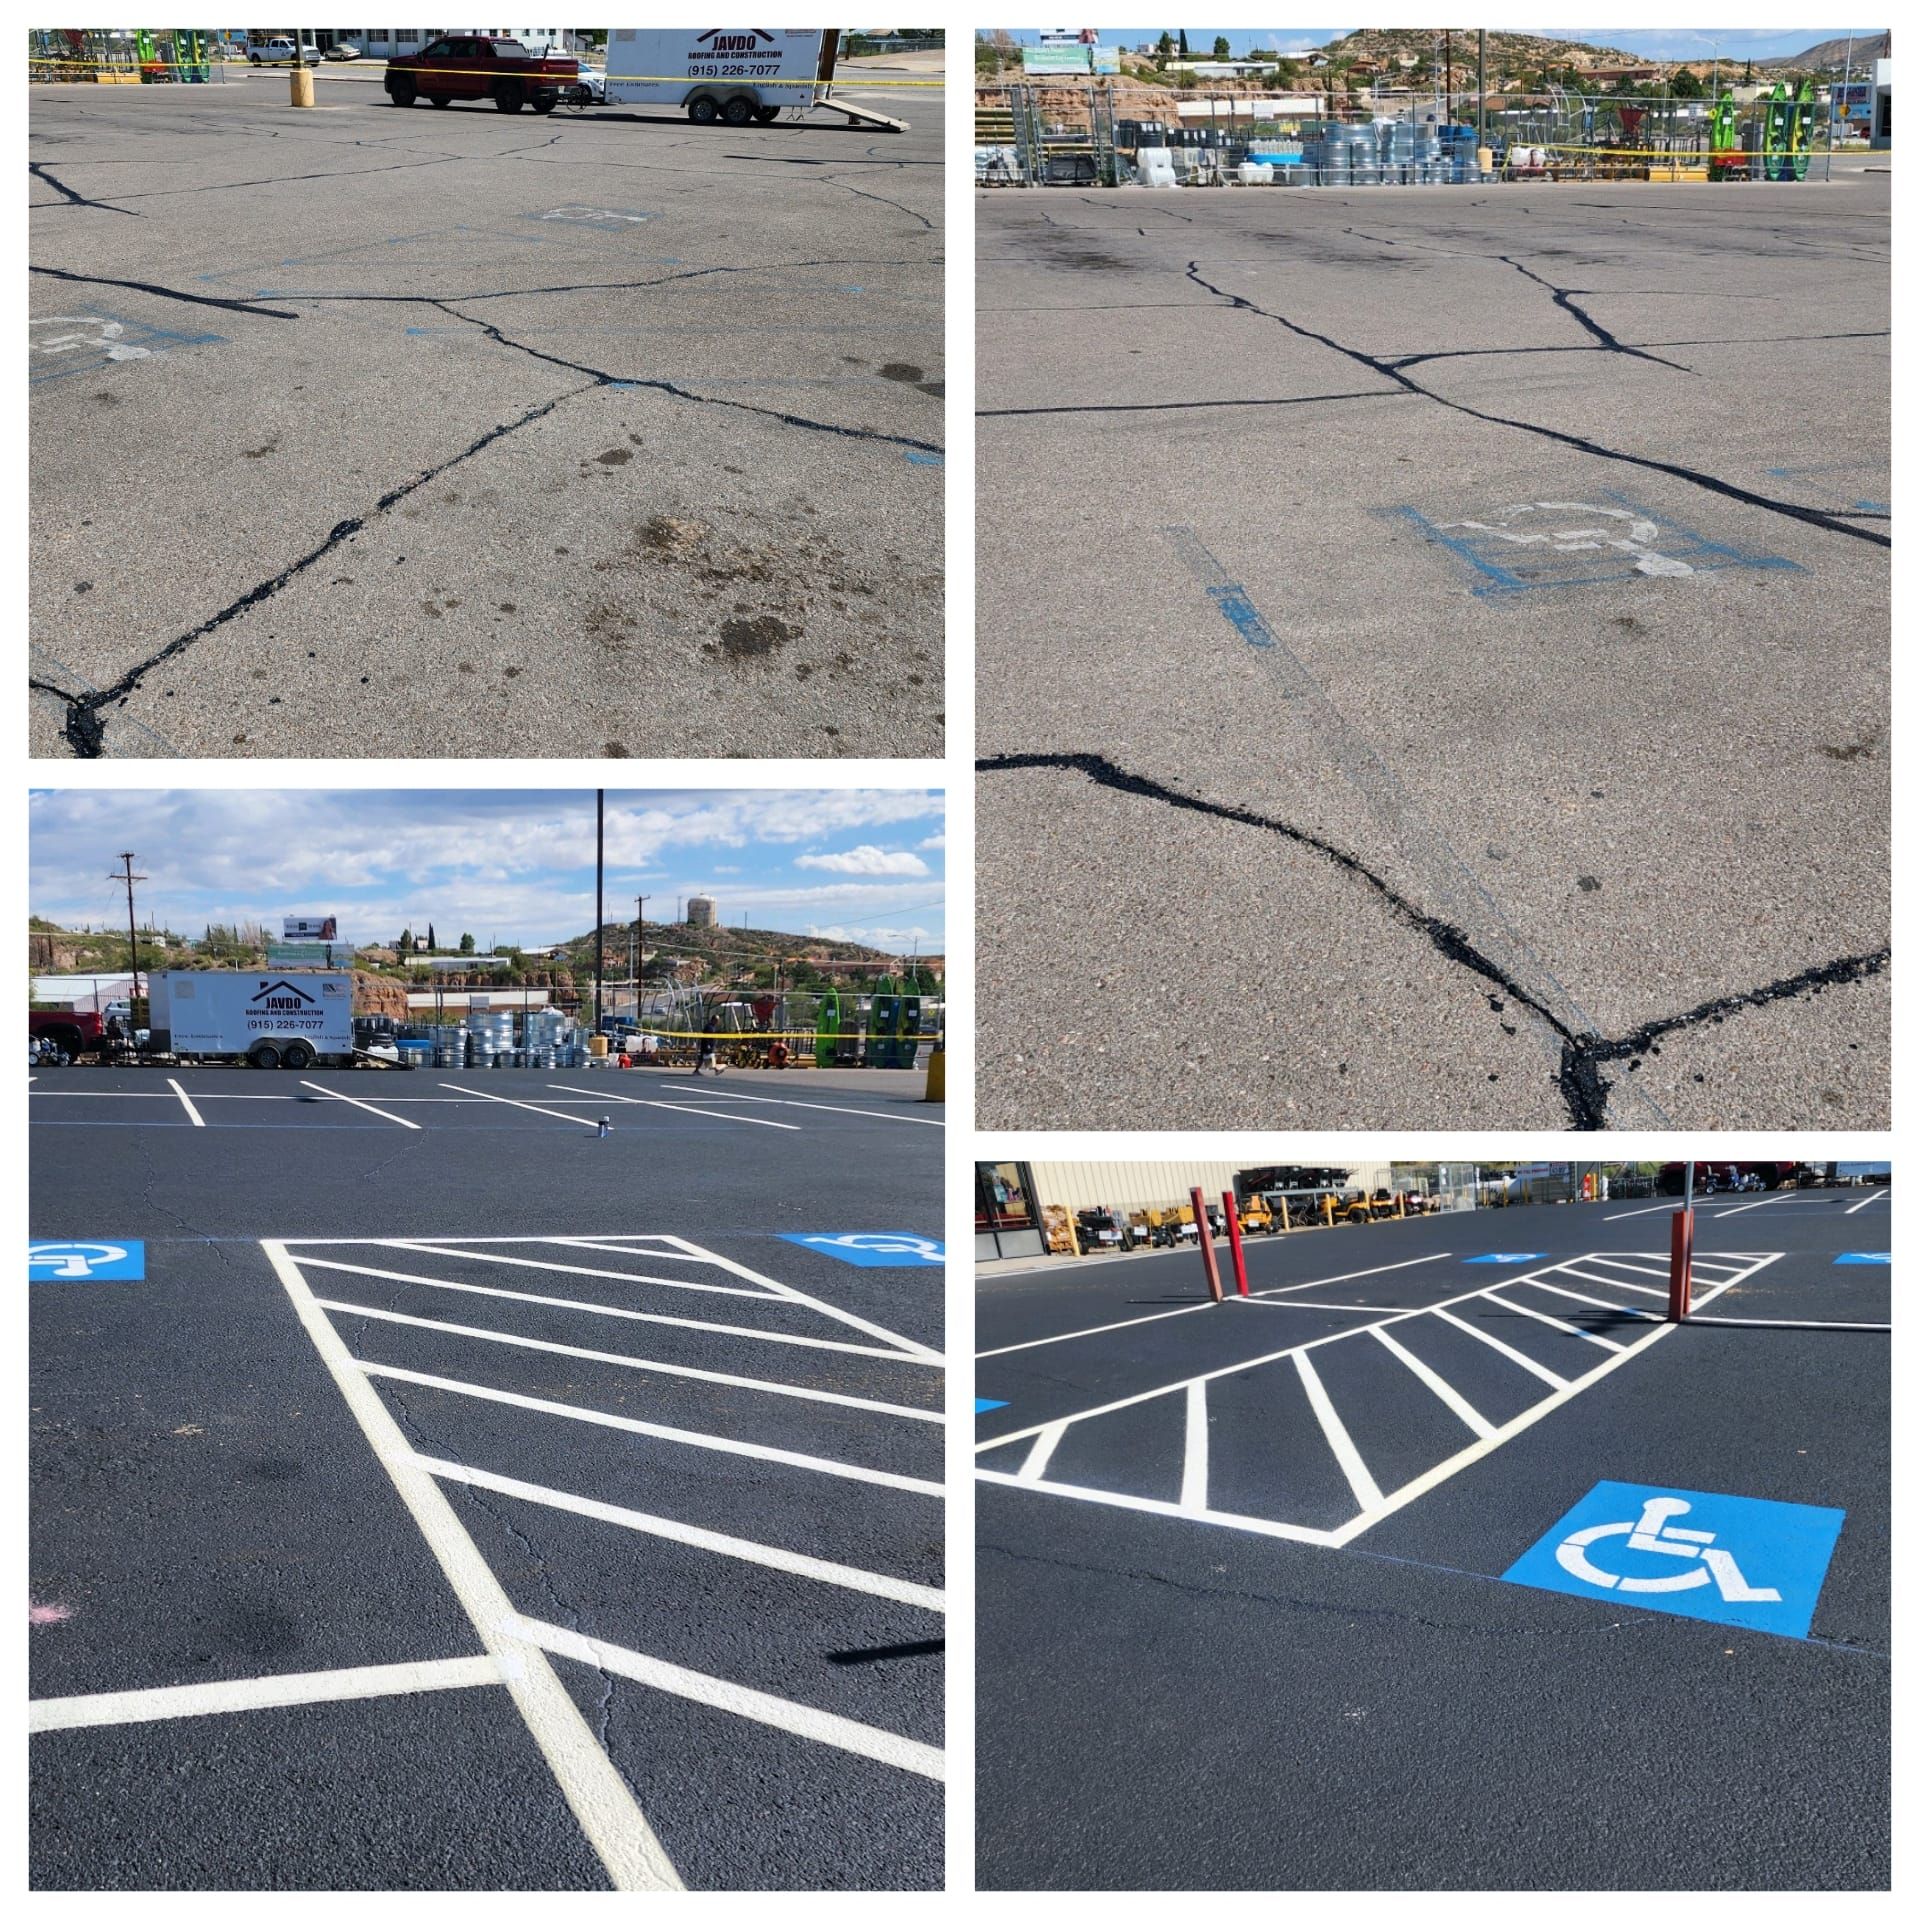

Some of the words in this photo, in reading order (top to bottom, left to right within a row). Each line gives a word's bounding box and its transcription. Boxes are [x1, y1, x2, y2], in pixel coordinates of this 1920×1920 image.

[711, 35, 757, 51] JAVDO
[688, 51, 715, 60] ROOFING
[716, 51, 730, 59] AND
[731, 50, 783, 59] CONSTRUCTION
[688, 64, 718, 77] (915)
[722, 64, 781, 76] 226-7077
[266, 997, 302, 1009] JAVDO
[248, 1020, 274, 1031] (915)
[276, 1020, 324, 1030] 226-7077
